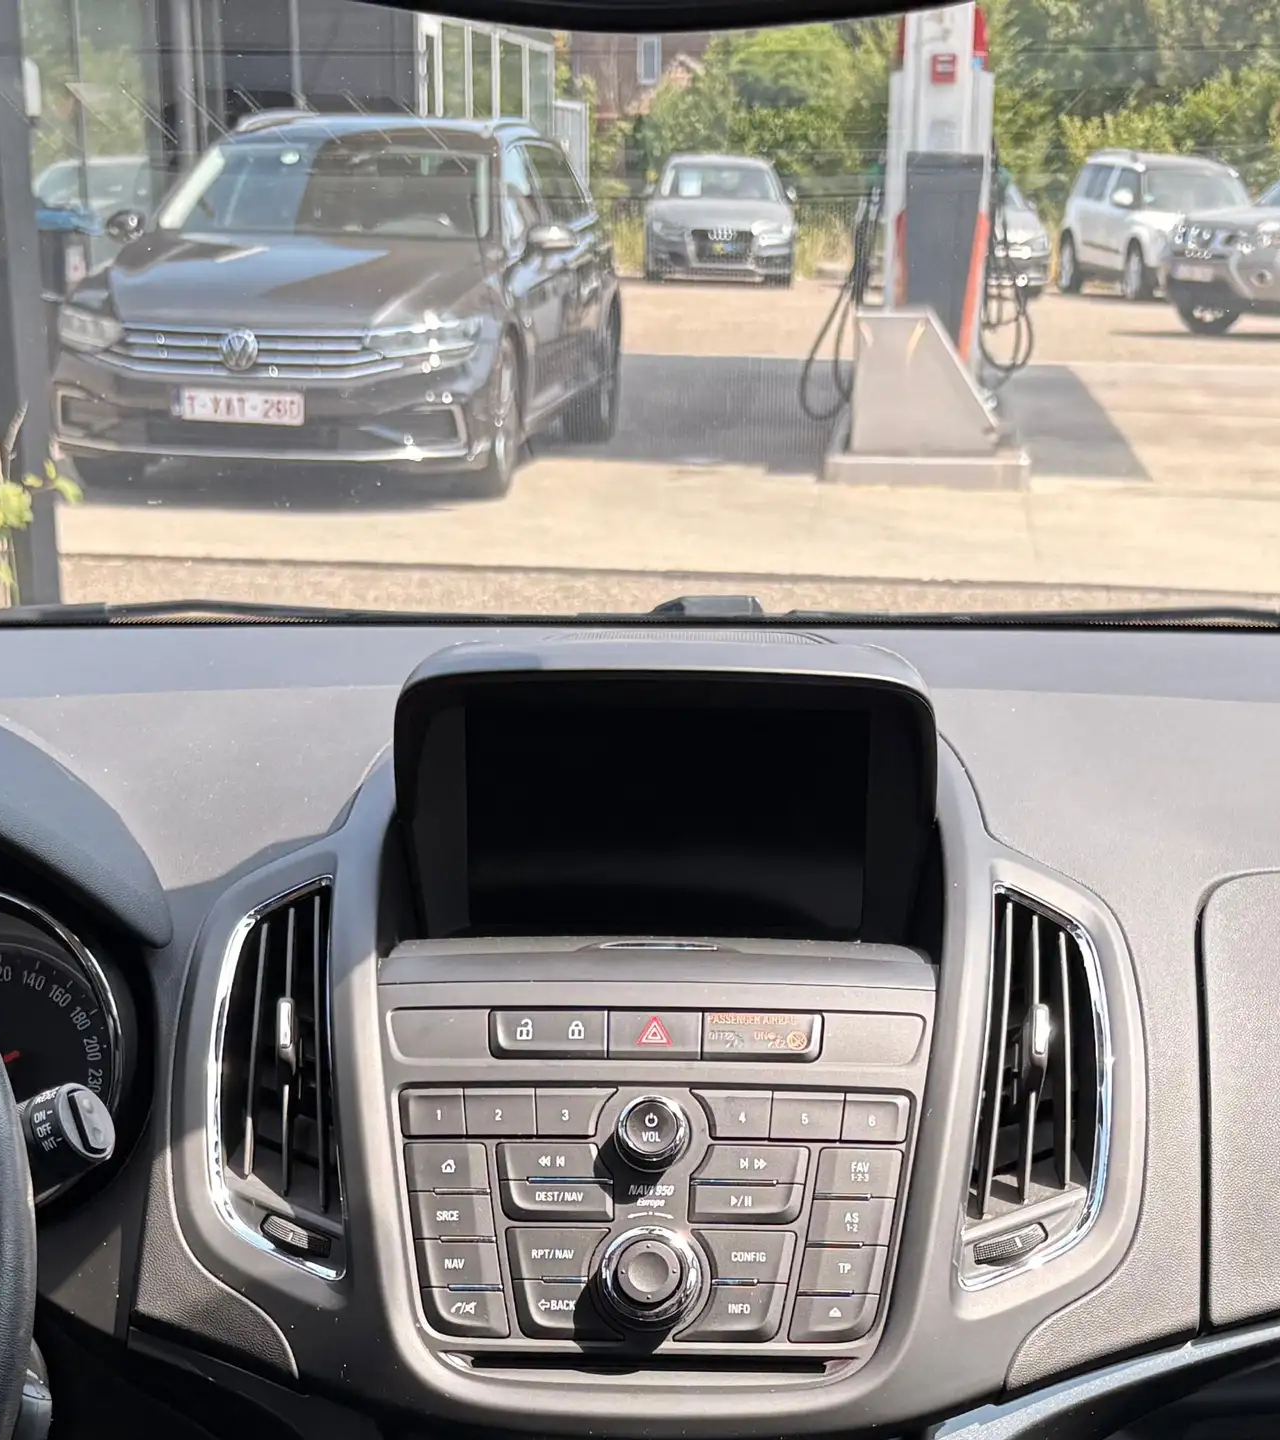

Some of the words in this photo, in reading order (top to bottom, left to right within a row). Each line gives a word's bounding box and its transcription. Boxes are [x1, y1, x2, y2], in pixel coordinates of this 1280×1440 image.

[23, 970, 46, 991] 140
[49, 984, 72, 1007] 160
[70, 1007, 91, 1031] 180
[708, 1014, 760, 1025] PASSENGER
[763, 1015, 797, 1025] AIRBAG
[83, 1037, 102, 1061] 200
[34, 1110, 46, 1123] ON
[436, 1110, 443, 1121] 1
[494, 1110, 502, 1121] 2
[561, 1110, 570, 1122] 3
[738, 1112, 746, 1124] 4
[800, 1113, 809, 1125] 5
[868, 1116, 876, 1128] 6
[36, 1122, 52, 1138] OFF
[642, 1131, 661, 1143] VOL
[42, 1137, 57, 1151] INT
[851, 1162, 870, 1175] FAV
[851, 1173, 869, 1182] 1-2-3
[655, 1185, 675, 1196] 950
[535, 1191, 584, 1203] DEST/NAV
[636, 1198, 666, 1208] Europe
[436, 1210, 460, 1222] SRCE
[844, 1214, 859, 1226] AS
[846, 1223, 858, 1232] 1-2
[531, 1249, 574, 1261] RPT/NAV
[731, 1250, 767, 1263] CONFIG
[444, 1258, 465, 1270] NAV
[838, 1262, 852, 1274] TP
[550, 1299, 576, 1312] BACK
[727, 1303, 751, 1315] INFO
